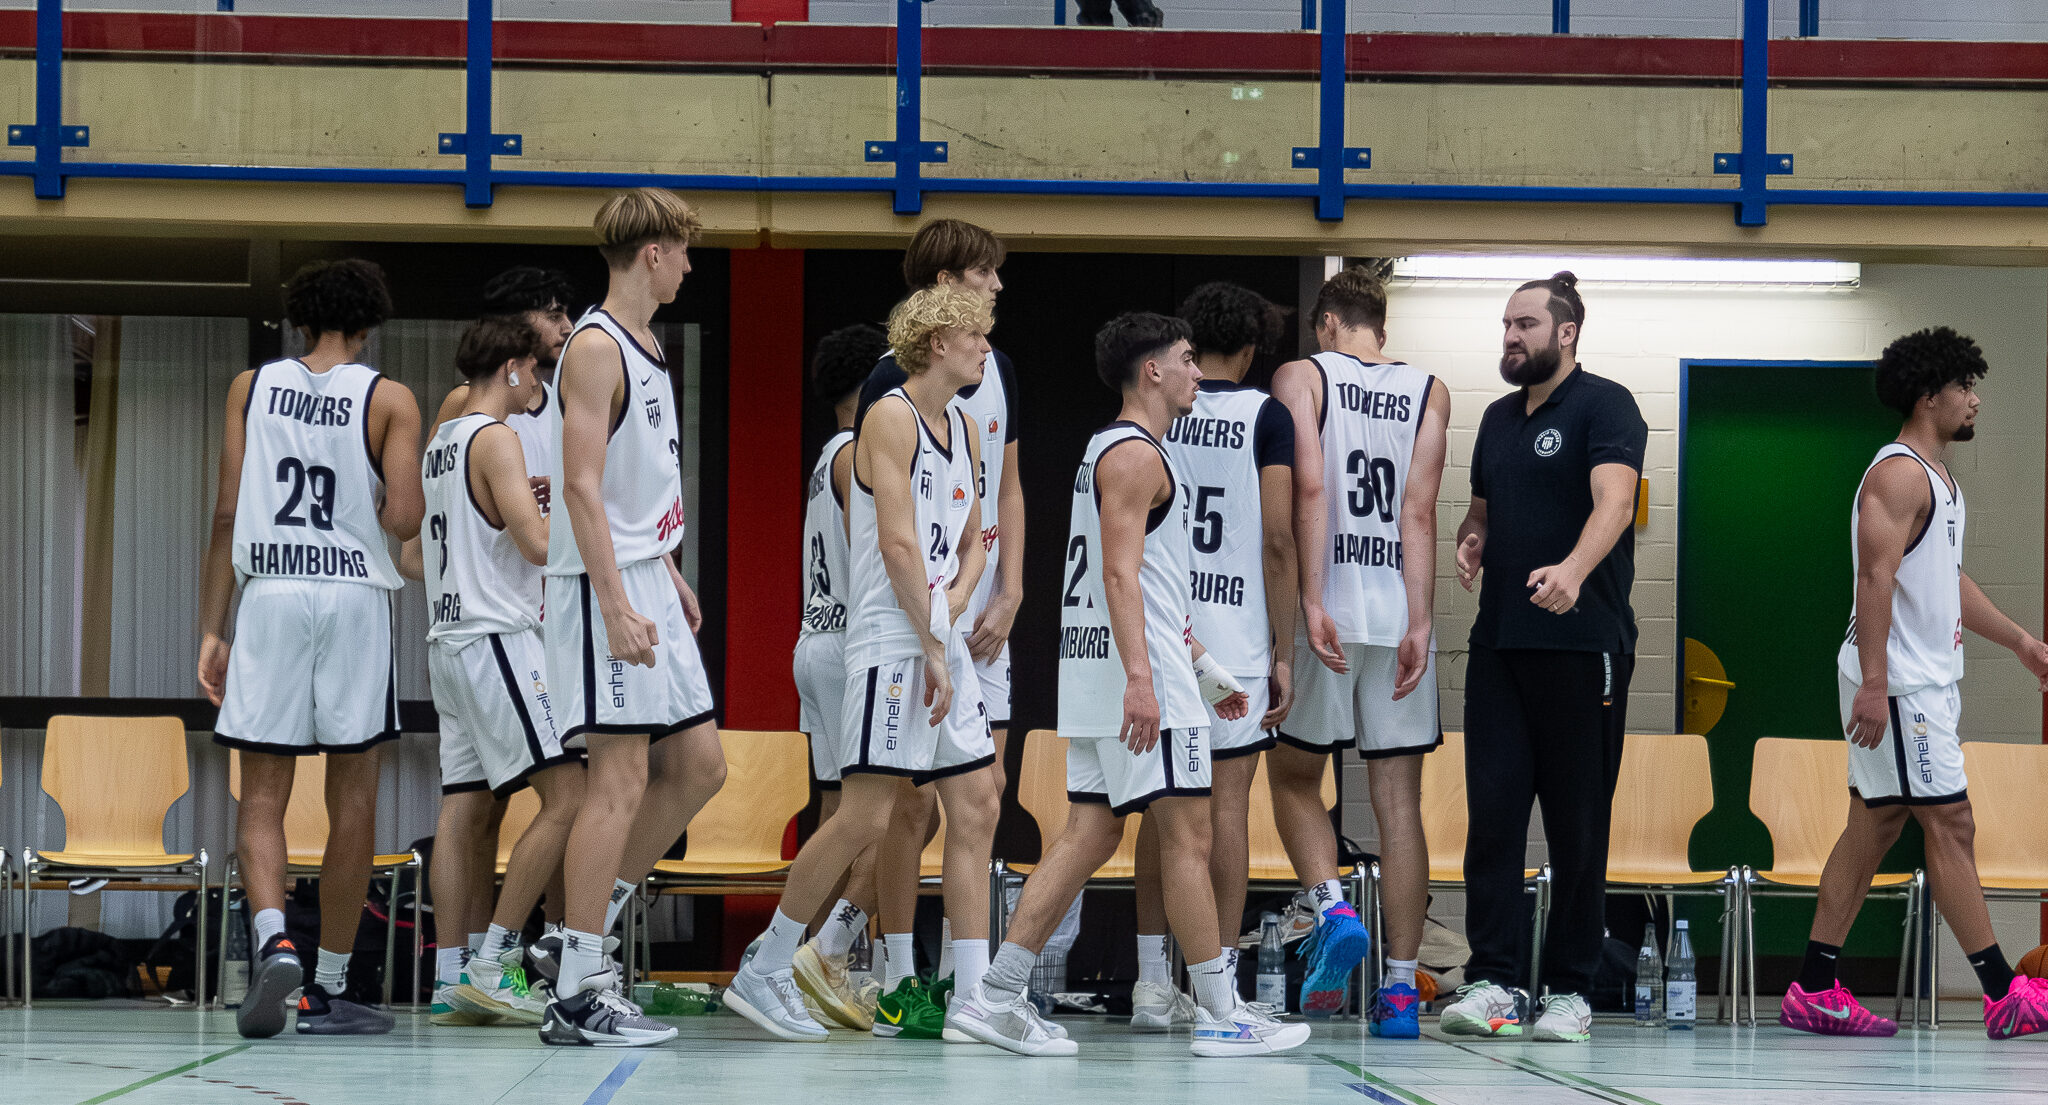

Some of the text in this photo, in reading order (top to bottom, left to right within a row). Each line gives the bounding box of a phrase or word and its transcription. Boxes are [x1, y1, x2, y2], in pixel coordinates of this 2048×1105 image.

[1166, 416, 1246, 450] OWERS
[274, 456, 336, 531] 29
[1347, 449, 1396, 523] 30
[250, 542, 369, 578] HAMBURG
[929, 522, 950, 562] 24
[1333, 533, 1402, 571] HAMBUR
[1063, 534, 1094, 609] 2
[1190, 569, 1245, 607] BURG
[1059, 625, 1110, 660] MBURG
[885, 672, 903, 751] enhelios
[1185, 727, 1199, 772] enhe
[1914, 712, 1933, 784] enhelios
[1226, 949, 1238, 969] EAK
